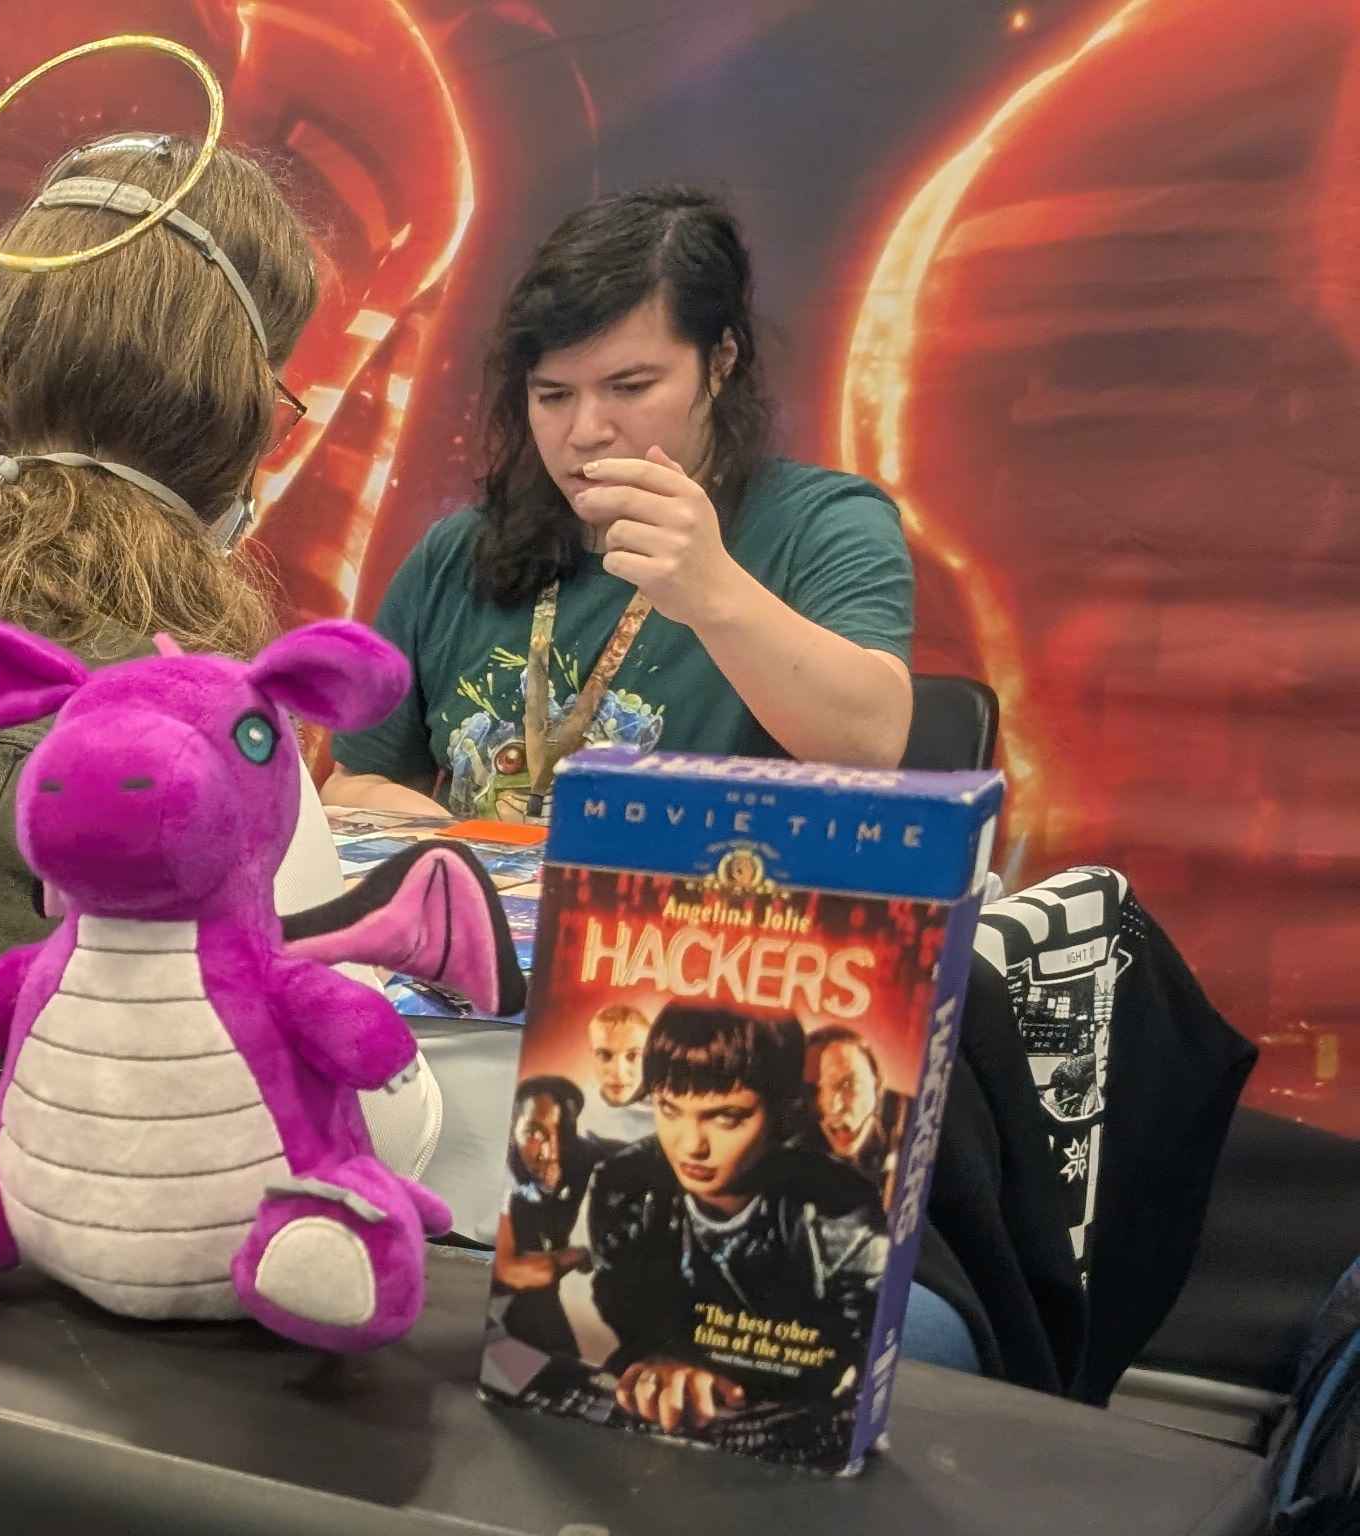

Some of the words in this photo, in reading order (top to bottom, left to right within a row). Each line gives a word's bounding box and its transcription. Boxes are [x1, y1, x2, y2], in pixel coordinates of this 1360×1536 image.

[583, 799, 752, 833] MOVIE
[788, 815, 925, 848] TIME
[661, 896, 753, 927] Angelina
[760, 905, 814, 933] Jolie
[580, 916, 876, 1019] HACKERS
[731, 1333, 751, 1352] of
[753, 1336, 780, 1359] the
[774, 1319, 821, 1343] cyber
